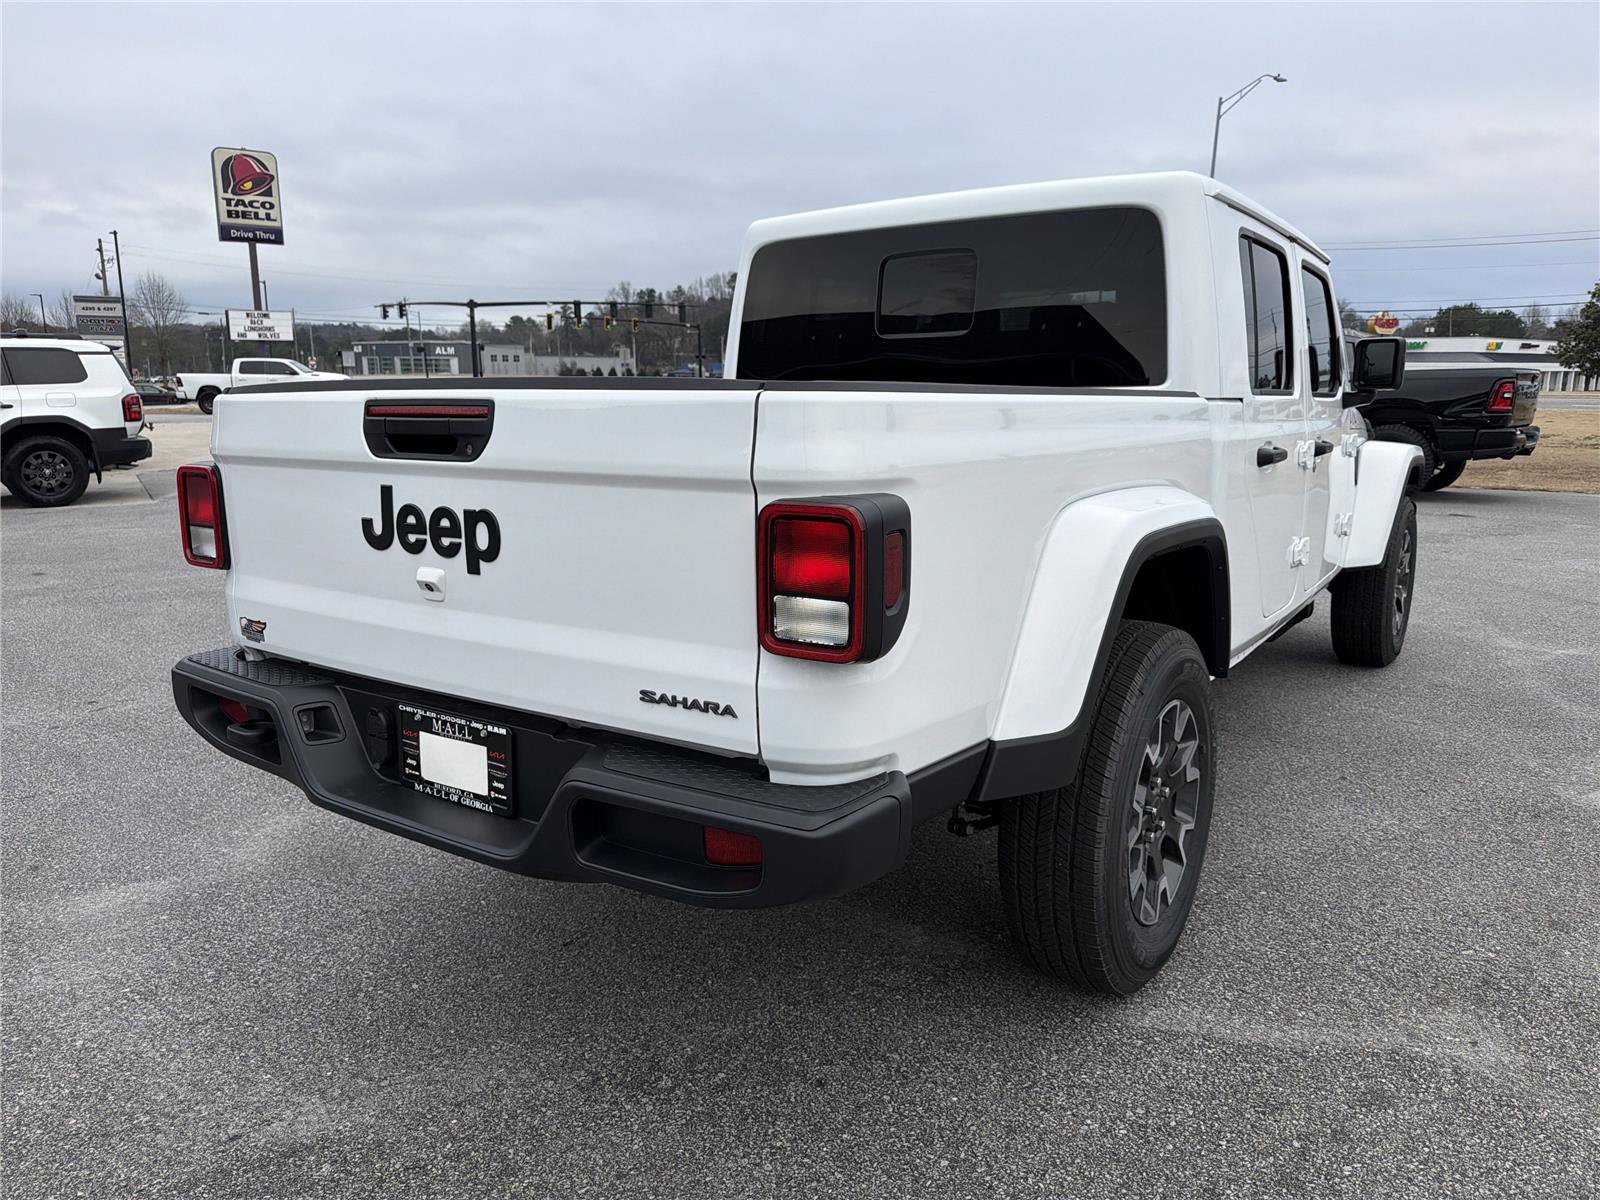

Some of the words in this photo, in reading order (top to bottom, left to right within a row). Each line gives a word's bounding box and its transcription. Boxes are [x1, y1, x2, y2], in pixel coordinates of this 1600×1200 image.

[221, 197, 275, 210] TACO
[226, 209, 277, 222] BELL
[230, 229, 254, 239] Drive
[255, 230, 275, 240] Thru
[435, 346, 455, 355] ALM
[361, 484, 501, 576] Jeep
[639, 689, 738, 719] SAHARA
[398, 704, 437, 718] CHRYSLER
[440, 714, 466, 725] DODGE
[470, 720, 483, 730] Jeep
[487, 724, 507, 735] RAM
[449, 793, 459, 803] OF
[460, 796, 494, 813] GEORGIA
